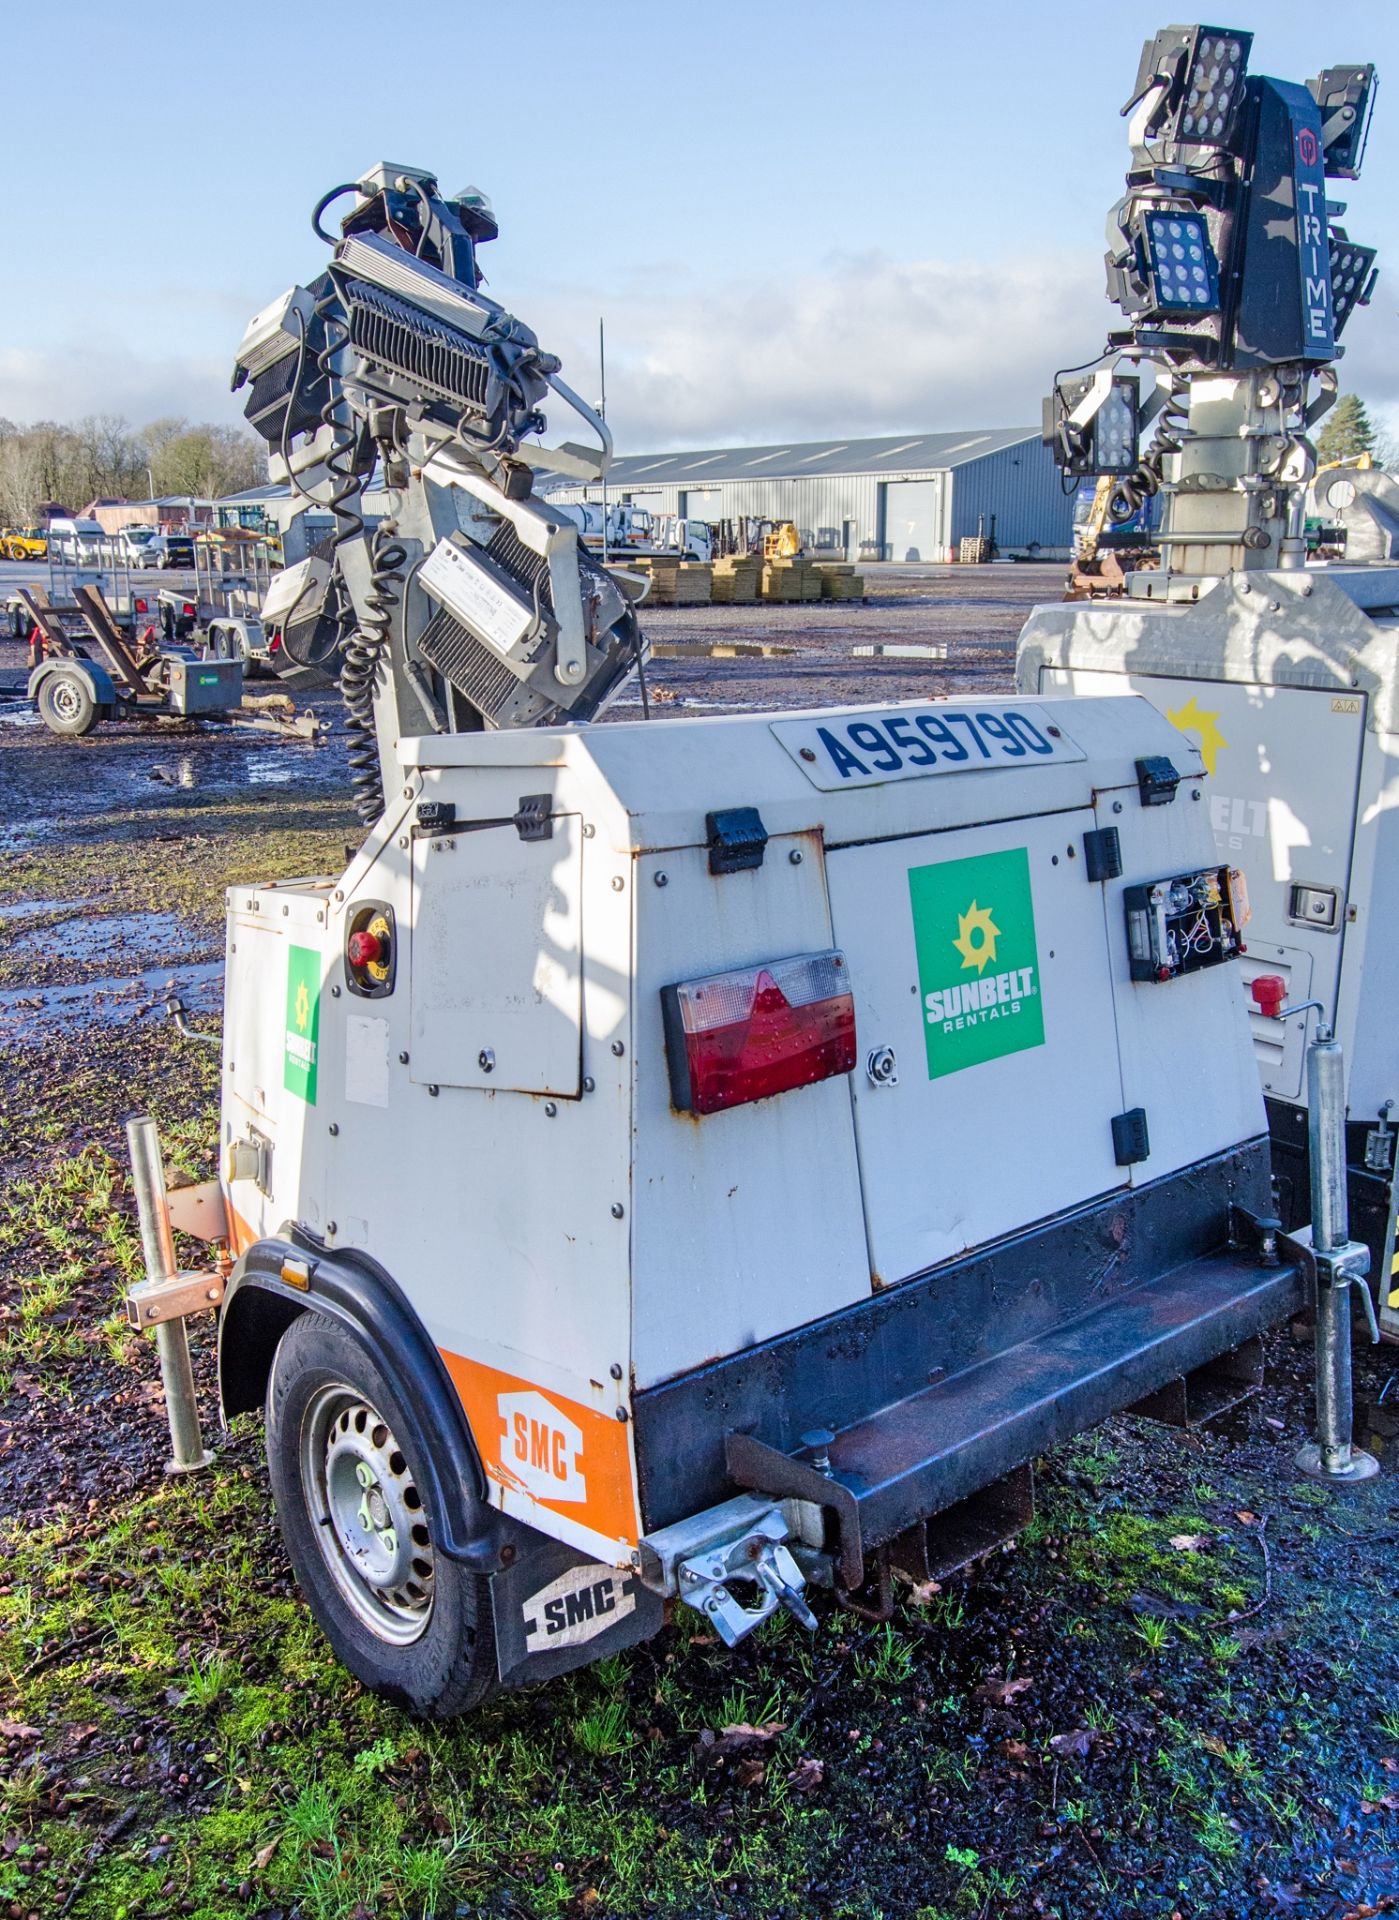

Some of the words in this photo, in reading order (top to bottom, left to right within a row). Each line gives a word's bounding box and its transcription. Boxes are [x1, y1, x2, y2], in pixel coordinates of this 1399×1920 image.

[1301, 183, 1327, 338] TRIME
[816, 712, 1053, 778] A959790
[1210, 795, 1266, 837] ELT
[943, 1001, 1021, 1034] RENTALS
[514, 1411, 567, 1482] SMC
[544, 1578, 615, 1636] SMC
